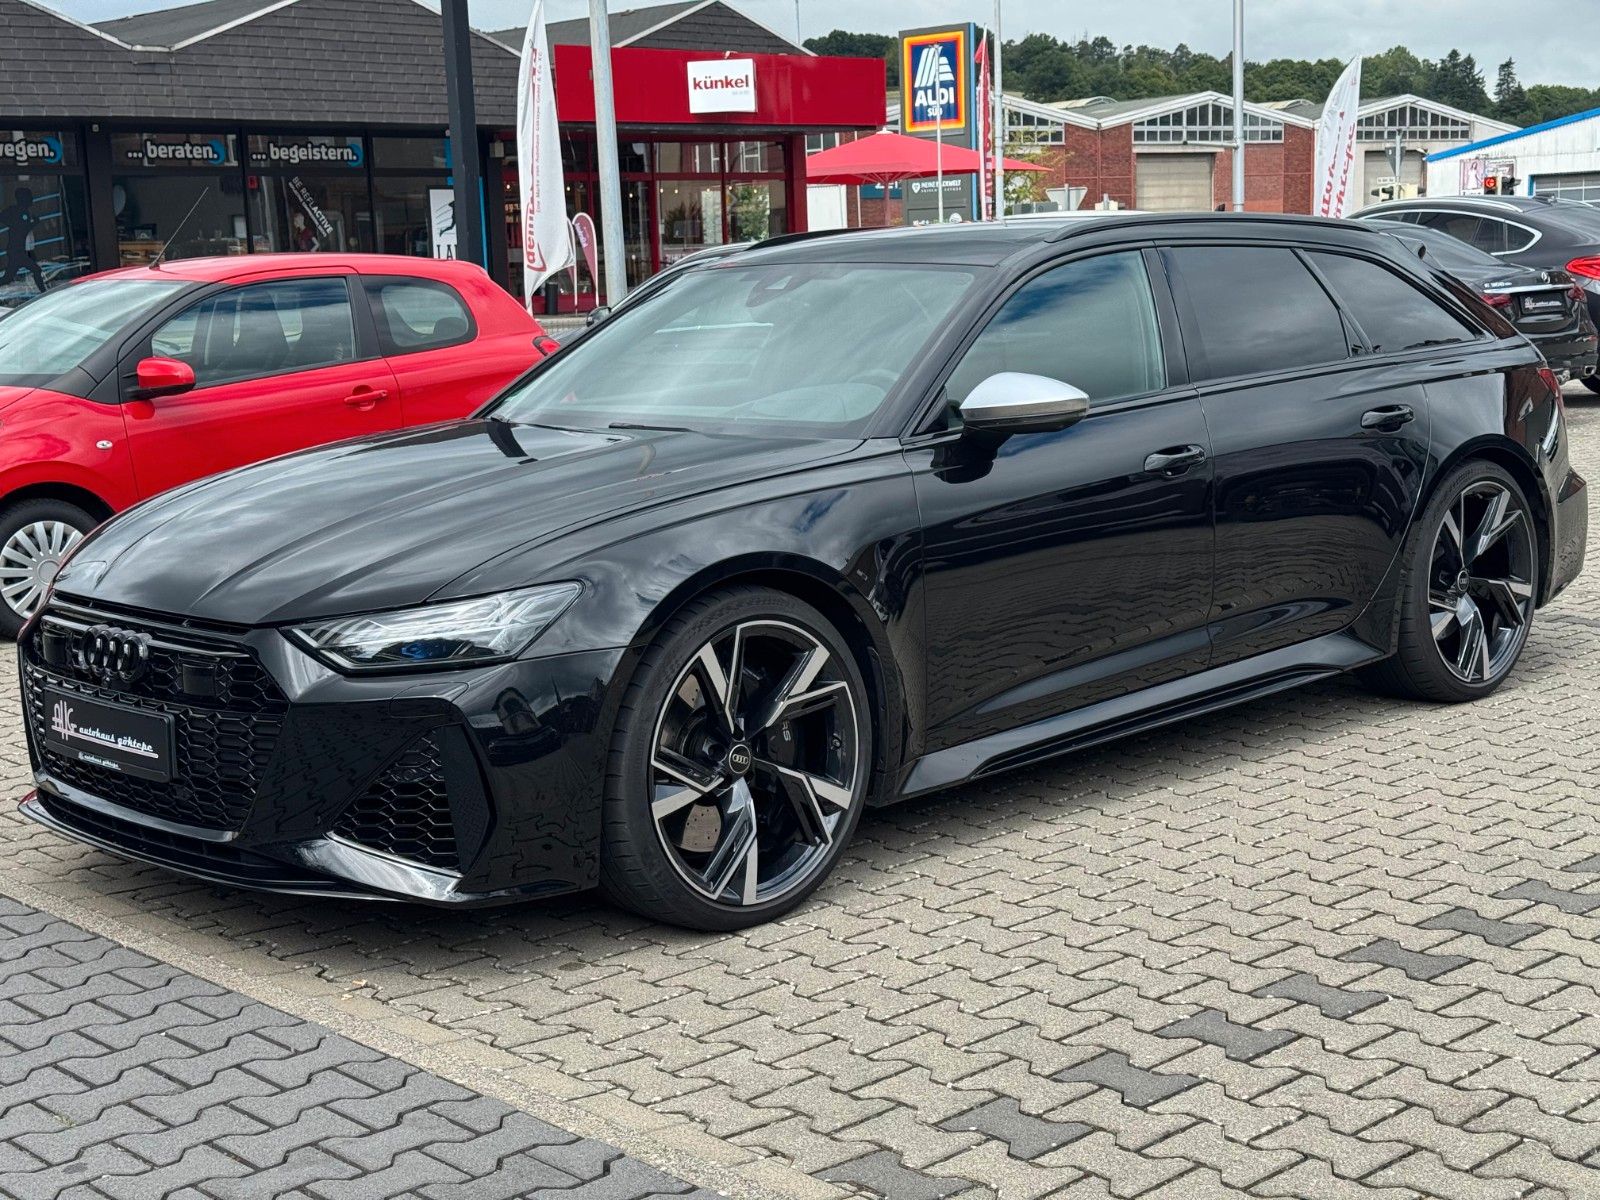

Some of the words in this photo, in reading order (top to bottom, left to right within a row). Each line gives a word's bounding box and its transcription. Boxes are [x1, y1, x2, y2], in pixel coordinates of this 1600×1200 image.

[693, 74, 749, 90] künkel
[914, 87, 955, 107] ALDI
[146, 141, 218, 159] beraten.
[269, 143, 357, 164] begeistern.
[291, 176, 303, 188] BE
[300, 187, 334, 235] REFLACTIVE
[79, 727, 116, 743] autohaus
[117, 736, 154, 752] göktepe
